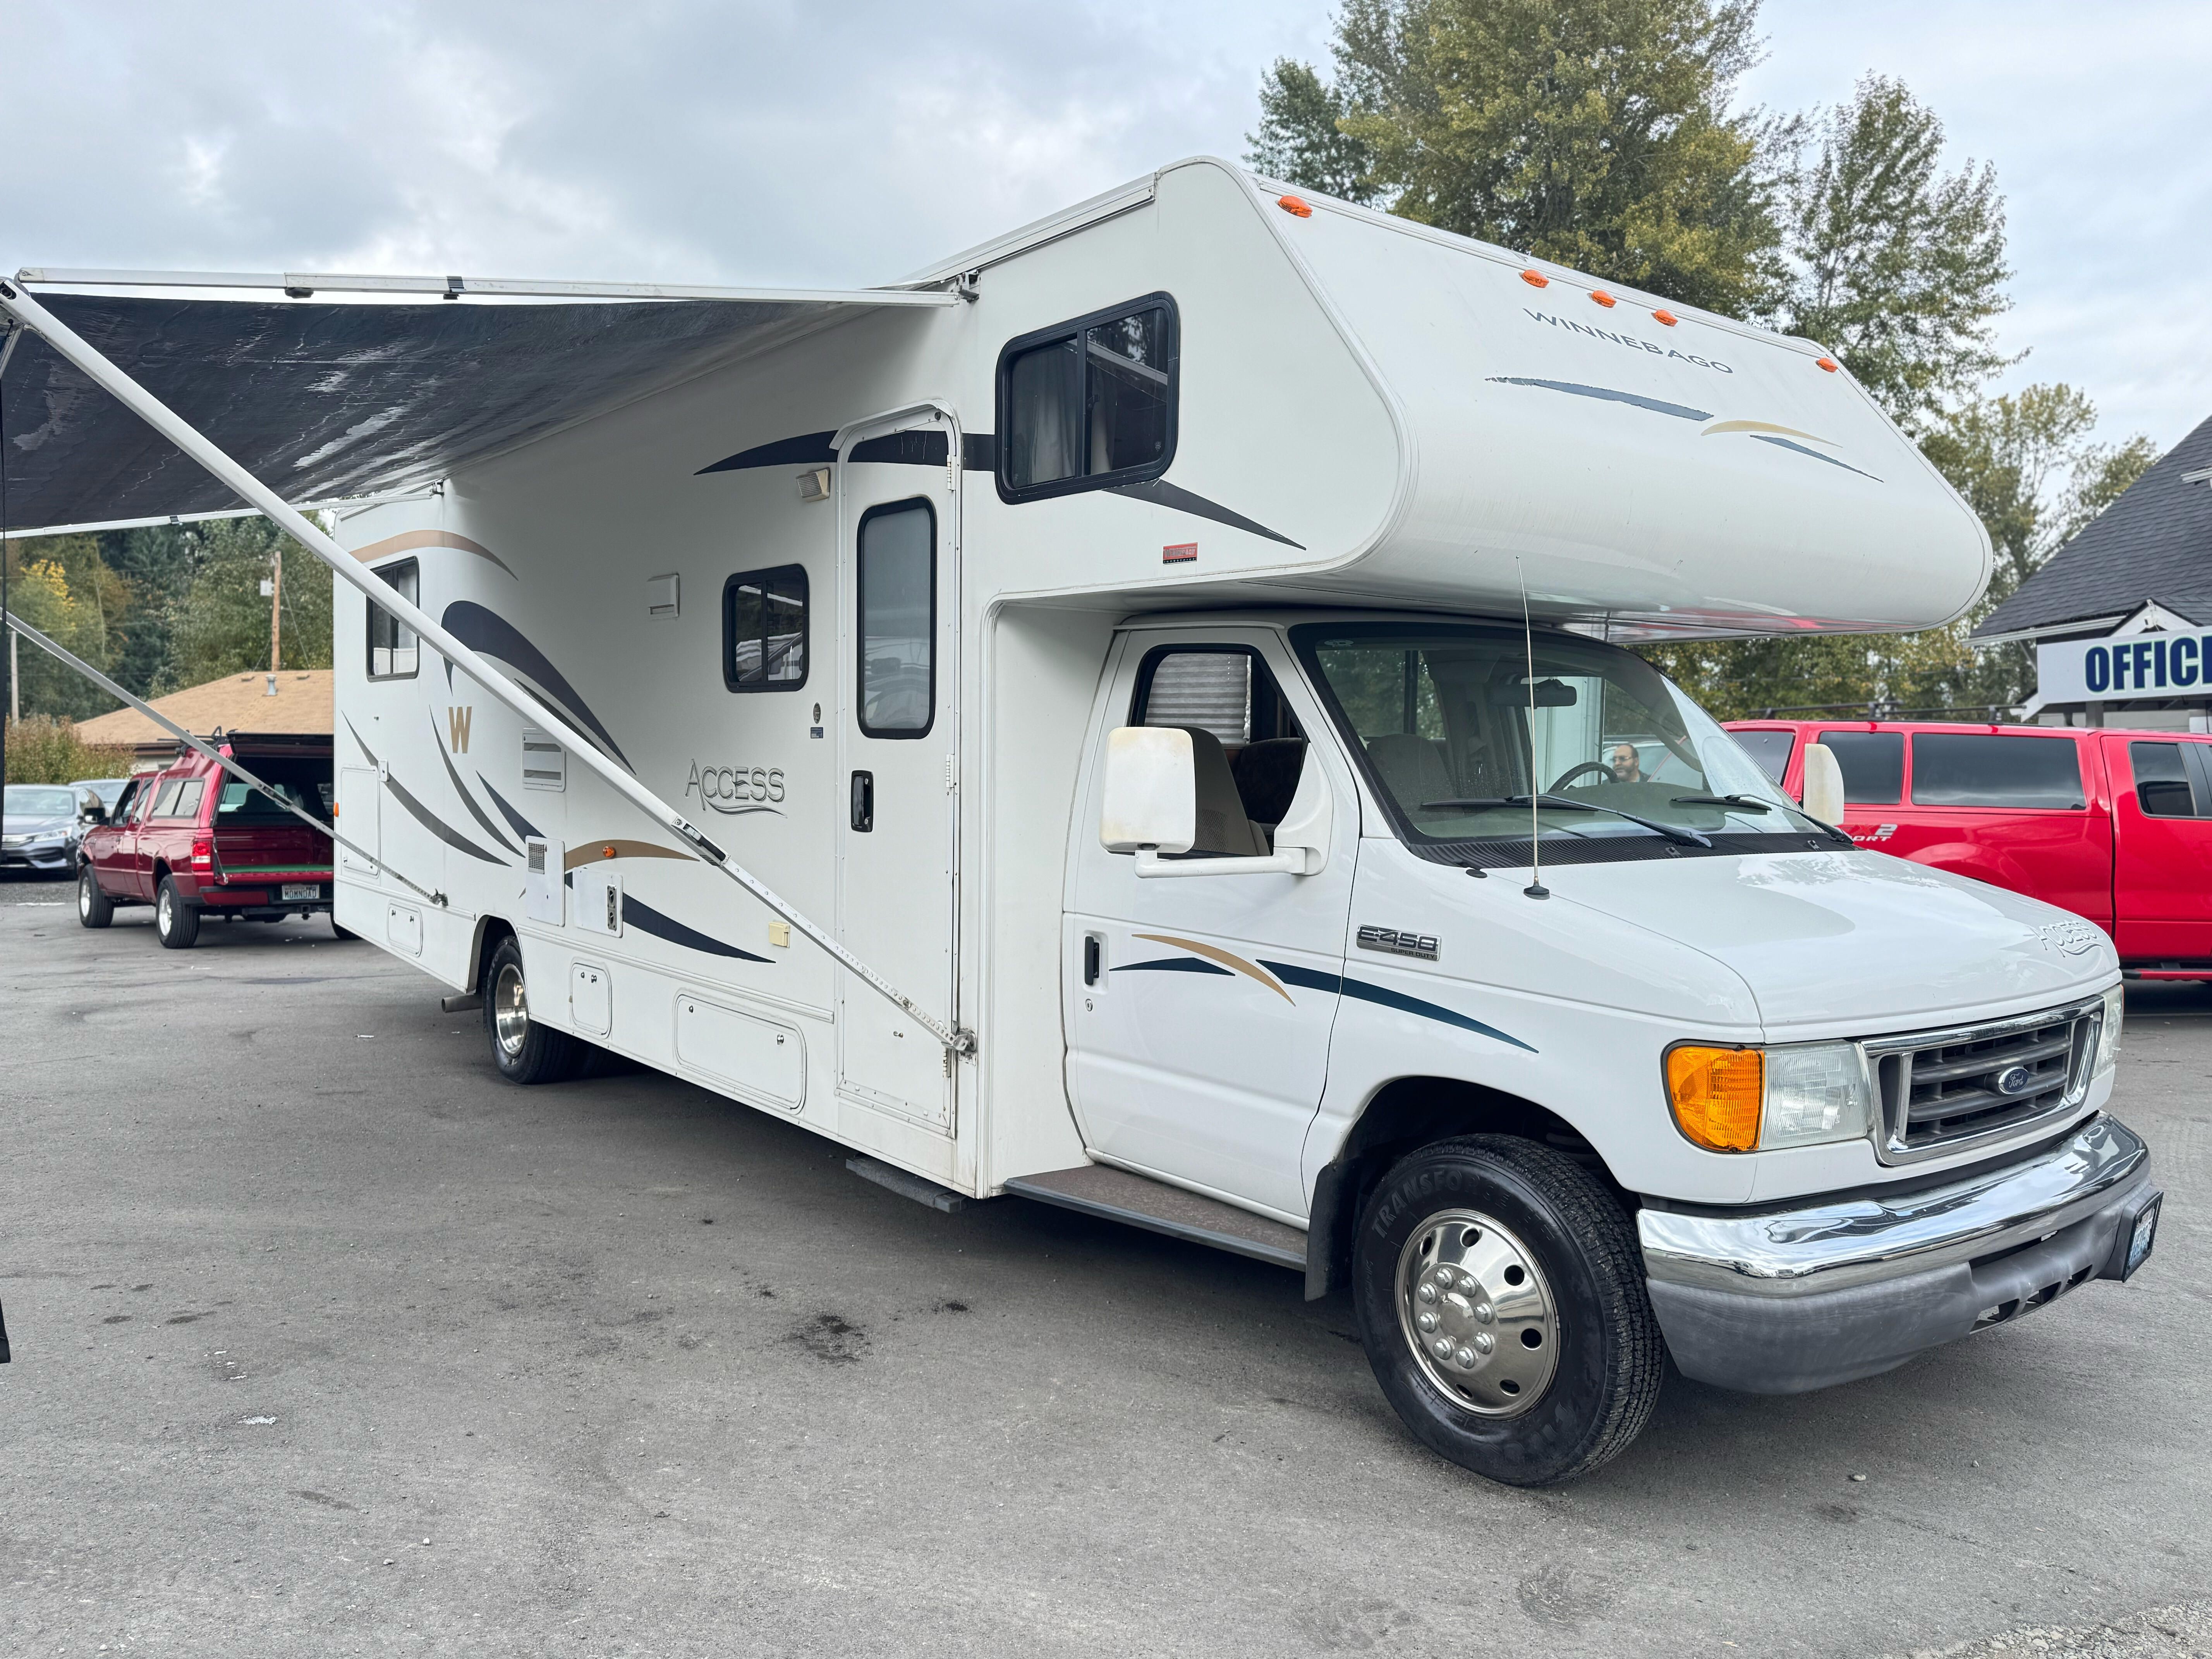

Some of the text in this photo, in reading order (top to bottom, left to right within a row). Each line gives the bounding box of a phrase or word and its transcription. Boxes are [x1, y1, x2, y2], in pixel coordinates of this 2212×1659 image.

[1523, 308, 1733, 373] WINNEBAGO
[448, 706, 472, 754] W
[685, 758, 785, 811] ACCESS
[2009, 1072, 2023, 1088] Ford
[1371, 1169, 1511, 1239] TRANSFORCE
